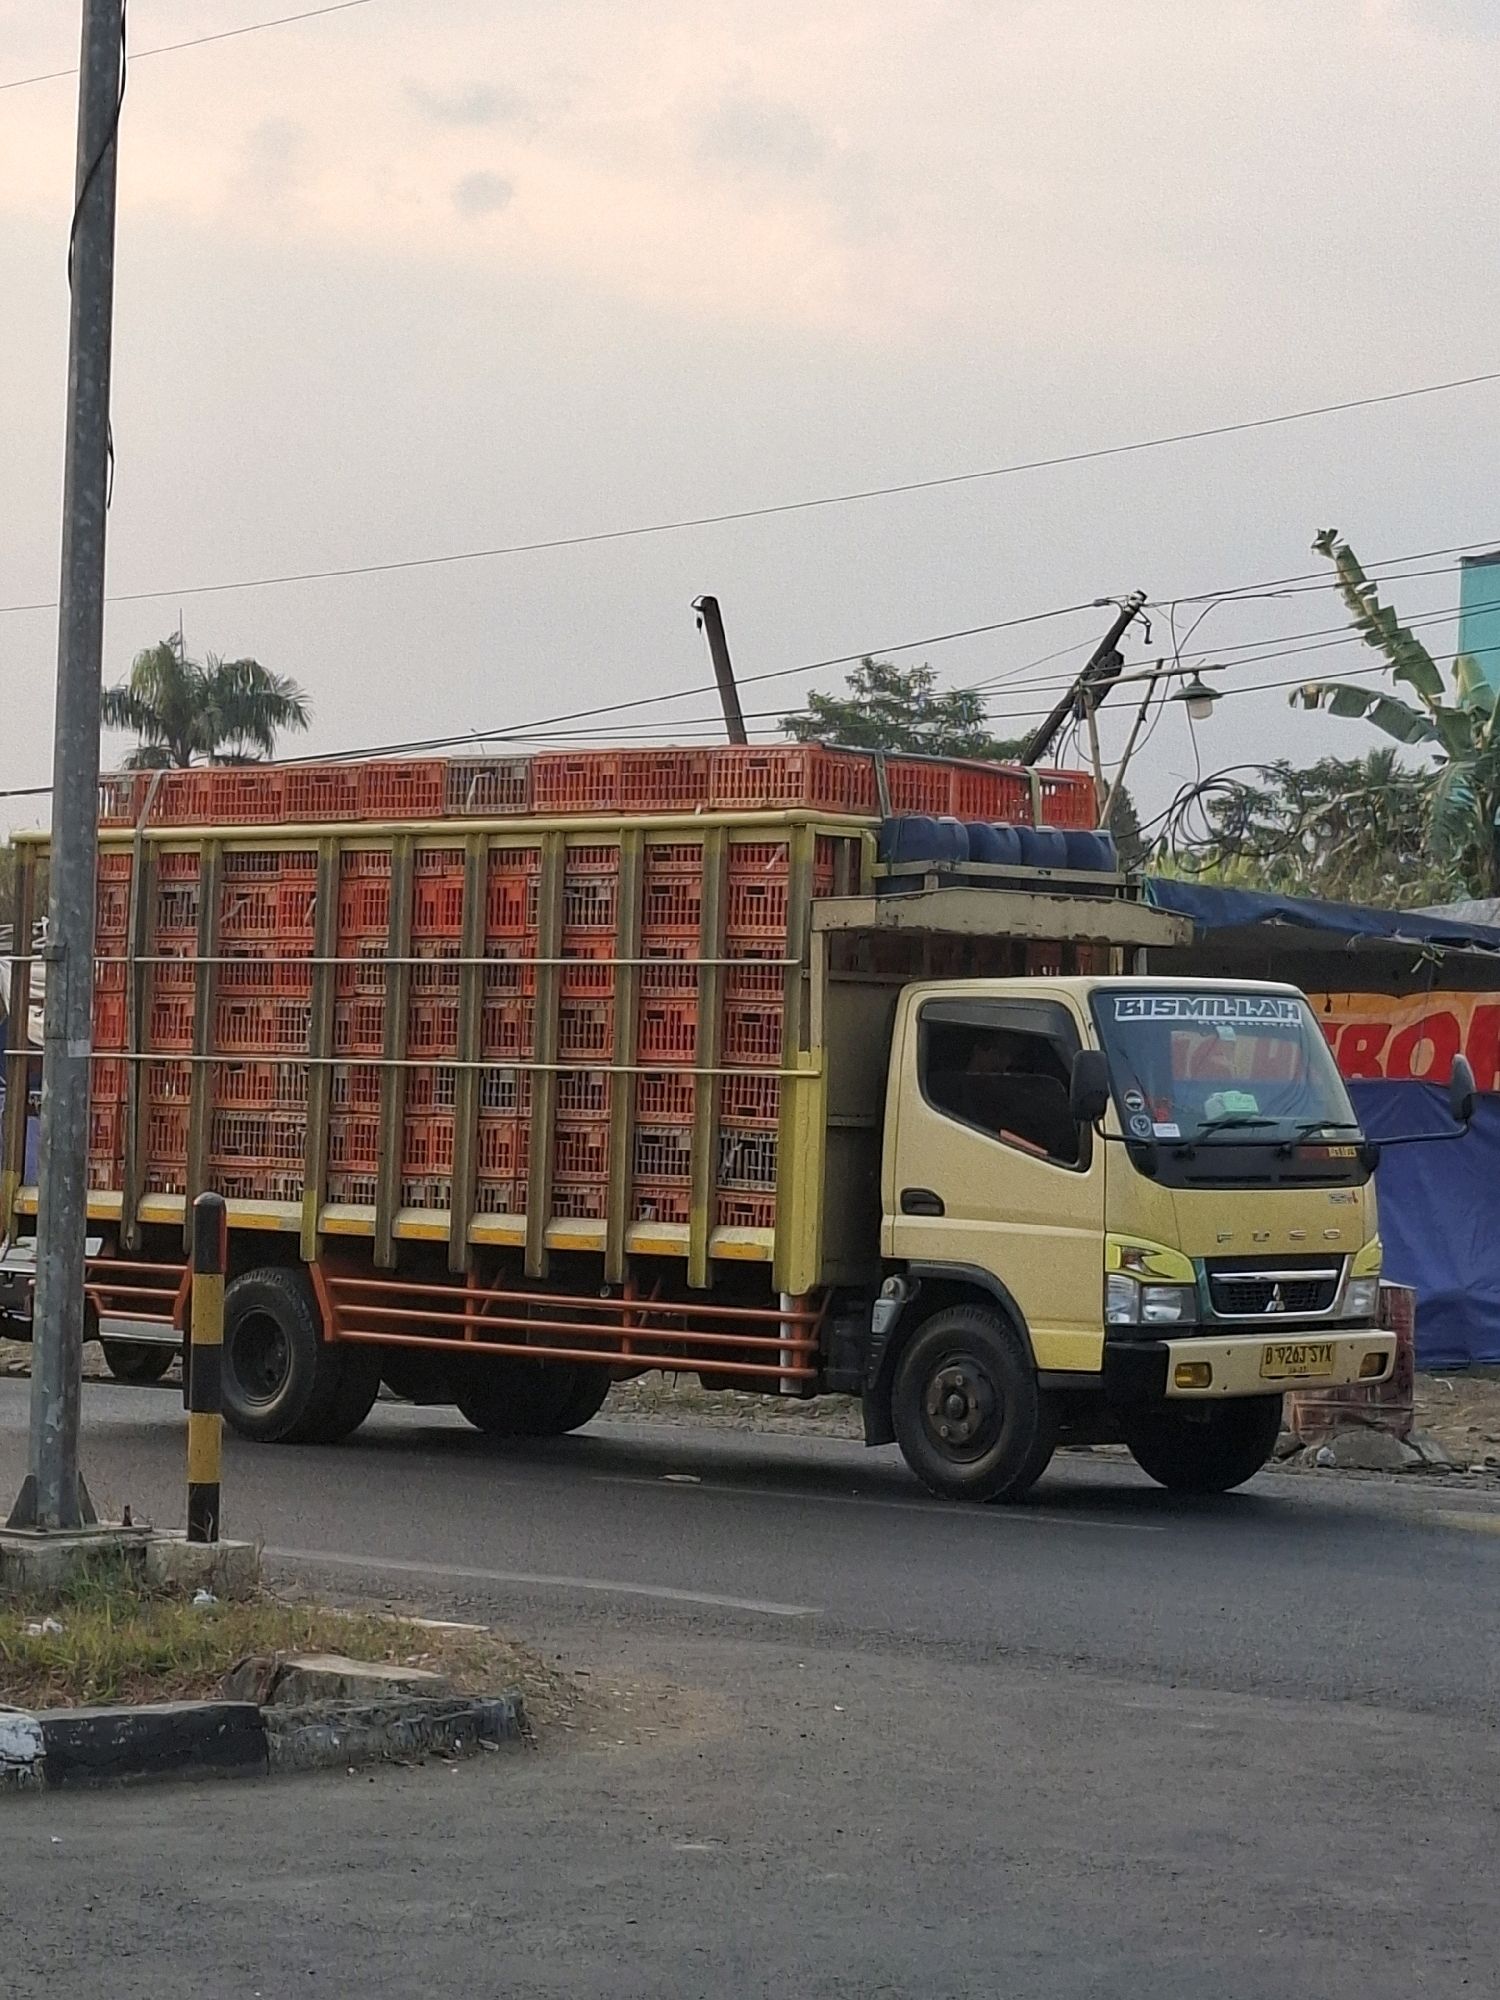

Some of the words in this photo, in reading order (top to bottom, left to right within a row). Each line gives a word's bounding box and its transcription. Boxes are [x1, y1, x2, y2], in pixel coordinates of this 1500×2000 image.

[1114, 997, 1302, 1022] BISMILLAH
[1216, 1228, 1341, 1243] FUSO
[1265, 1346, 1273, 1365] B
